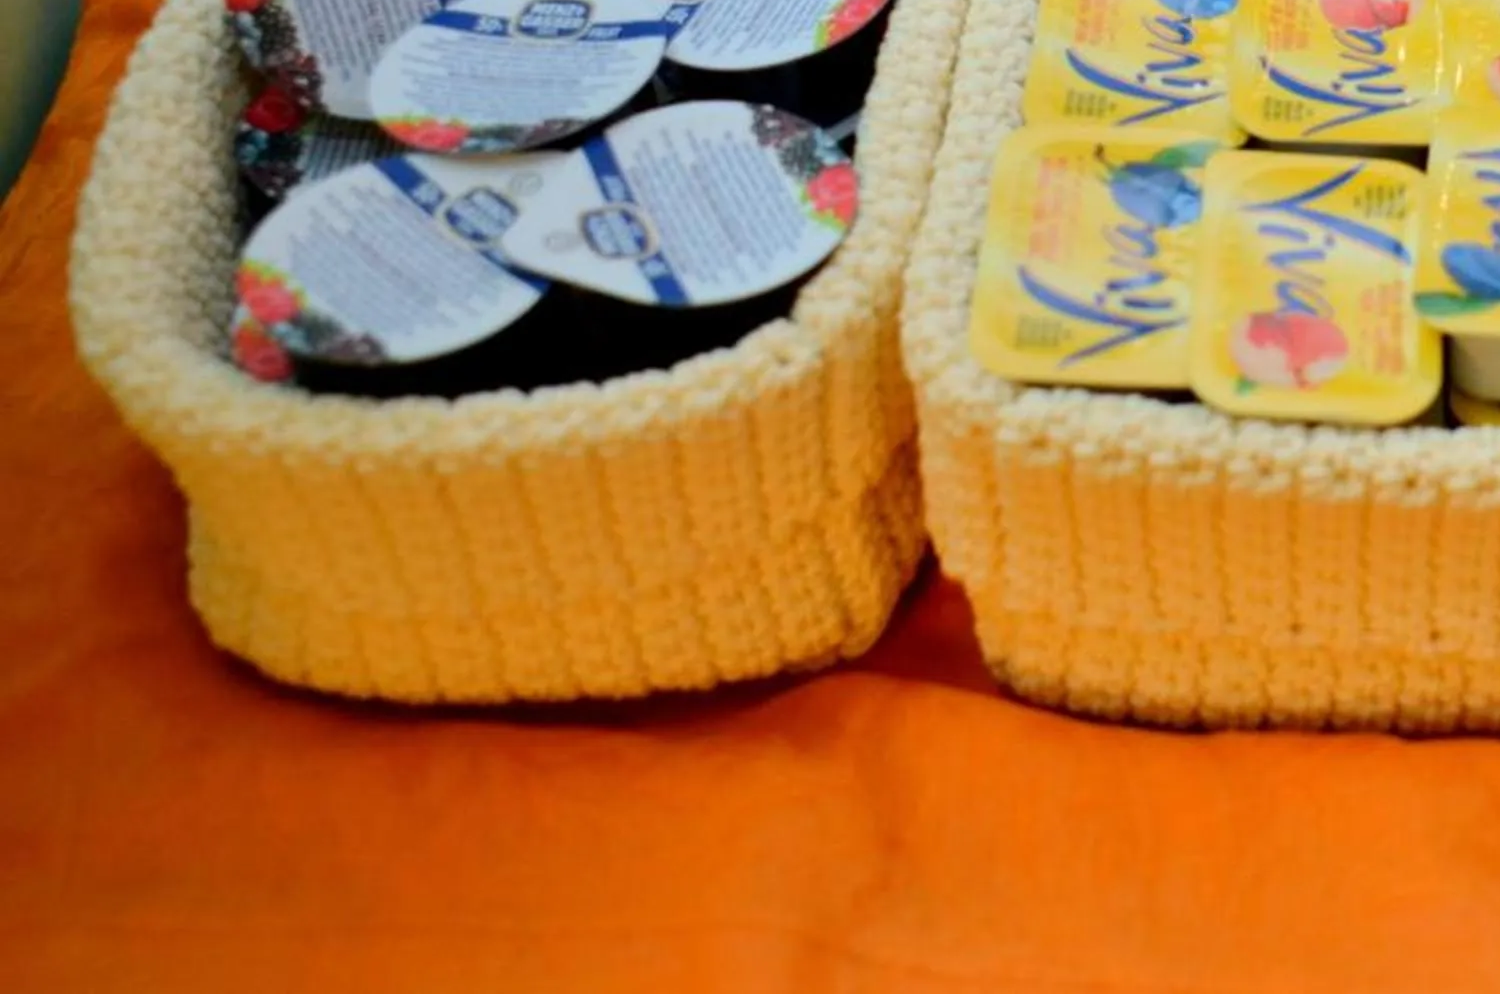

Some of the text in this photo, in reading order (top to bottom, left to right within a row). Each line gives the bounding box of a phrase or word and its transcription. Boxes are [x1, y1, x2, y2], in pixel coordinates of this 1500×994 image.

[1064, 16, 1226, 127] Viva
[1257, 28, 1421, 137] Viva
[1016, 222, 1189, 370] Viva
[1239, 158, 1412, 319] Viva
